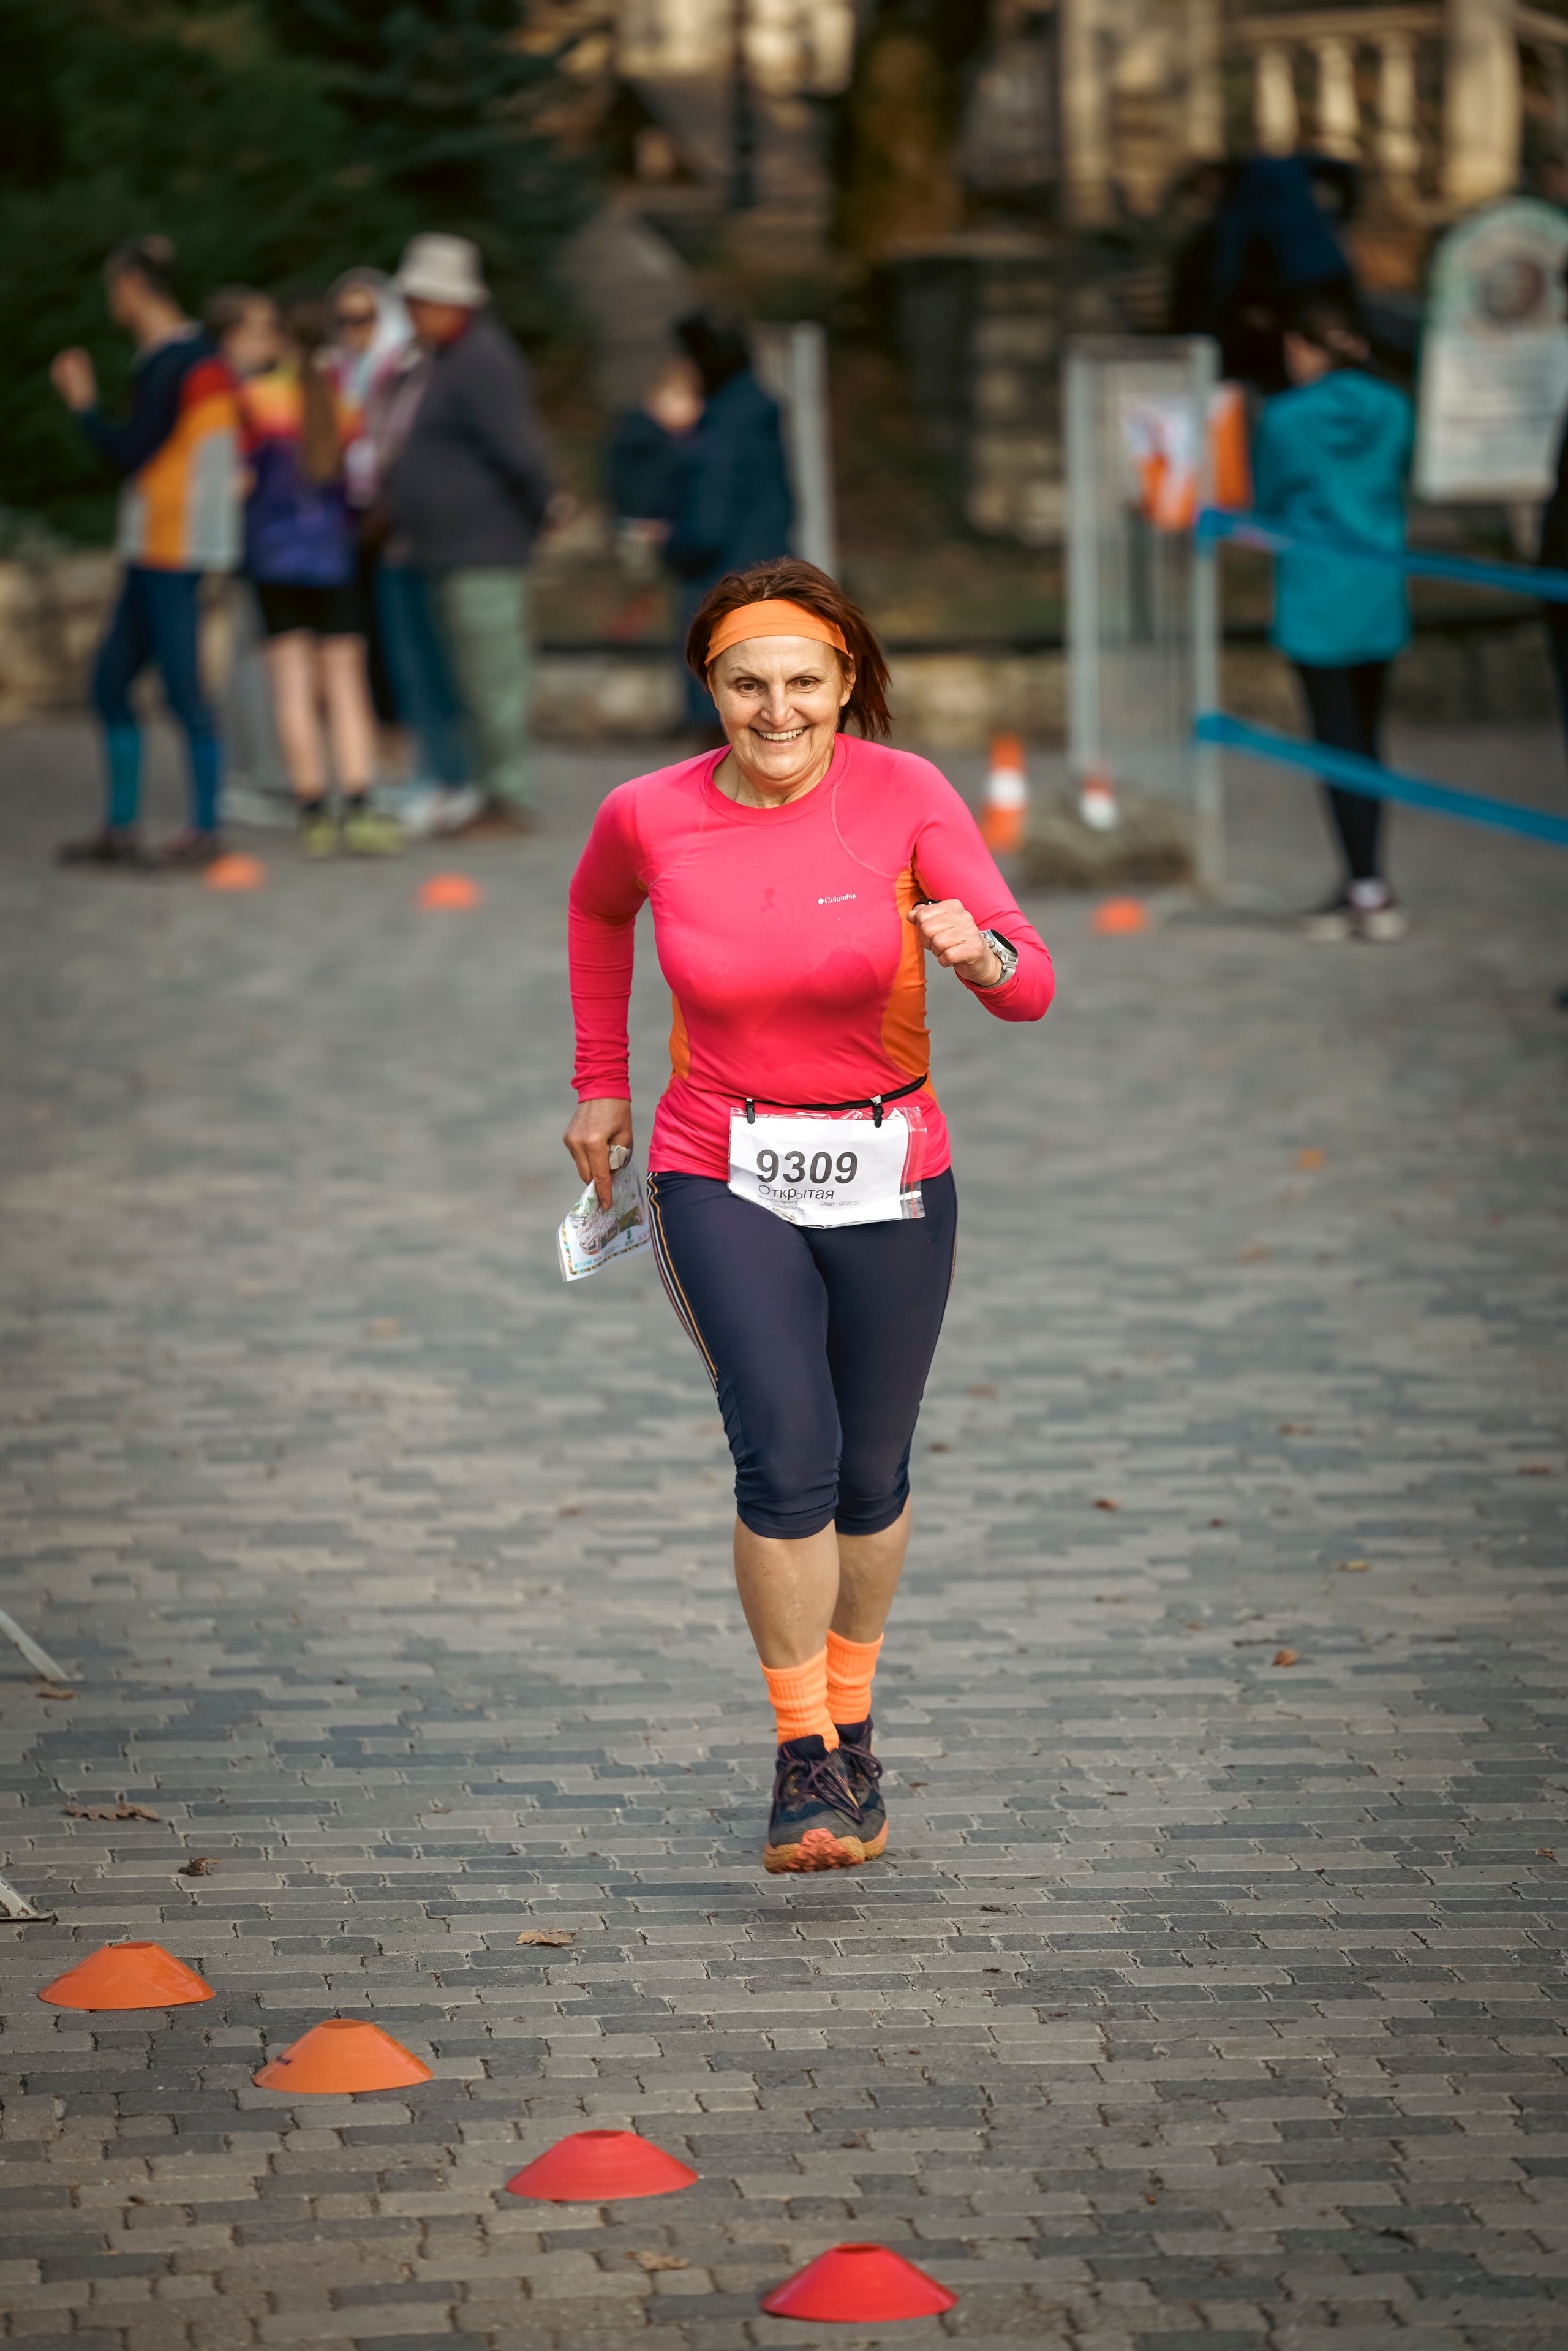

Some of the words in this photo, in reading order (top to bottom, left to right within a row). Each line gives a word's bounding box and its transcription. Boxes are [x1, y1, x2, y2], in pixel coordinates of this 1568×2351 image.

[824, 892, 856, 904] Columbia
[756, 1149, 858, 1184] 9309
[758, 1185, 834, 1201] Открытая
